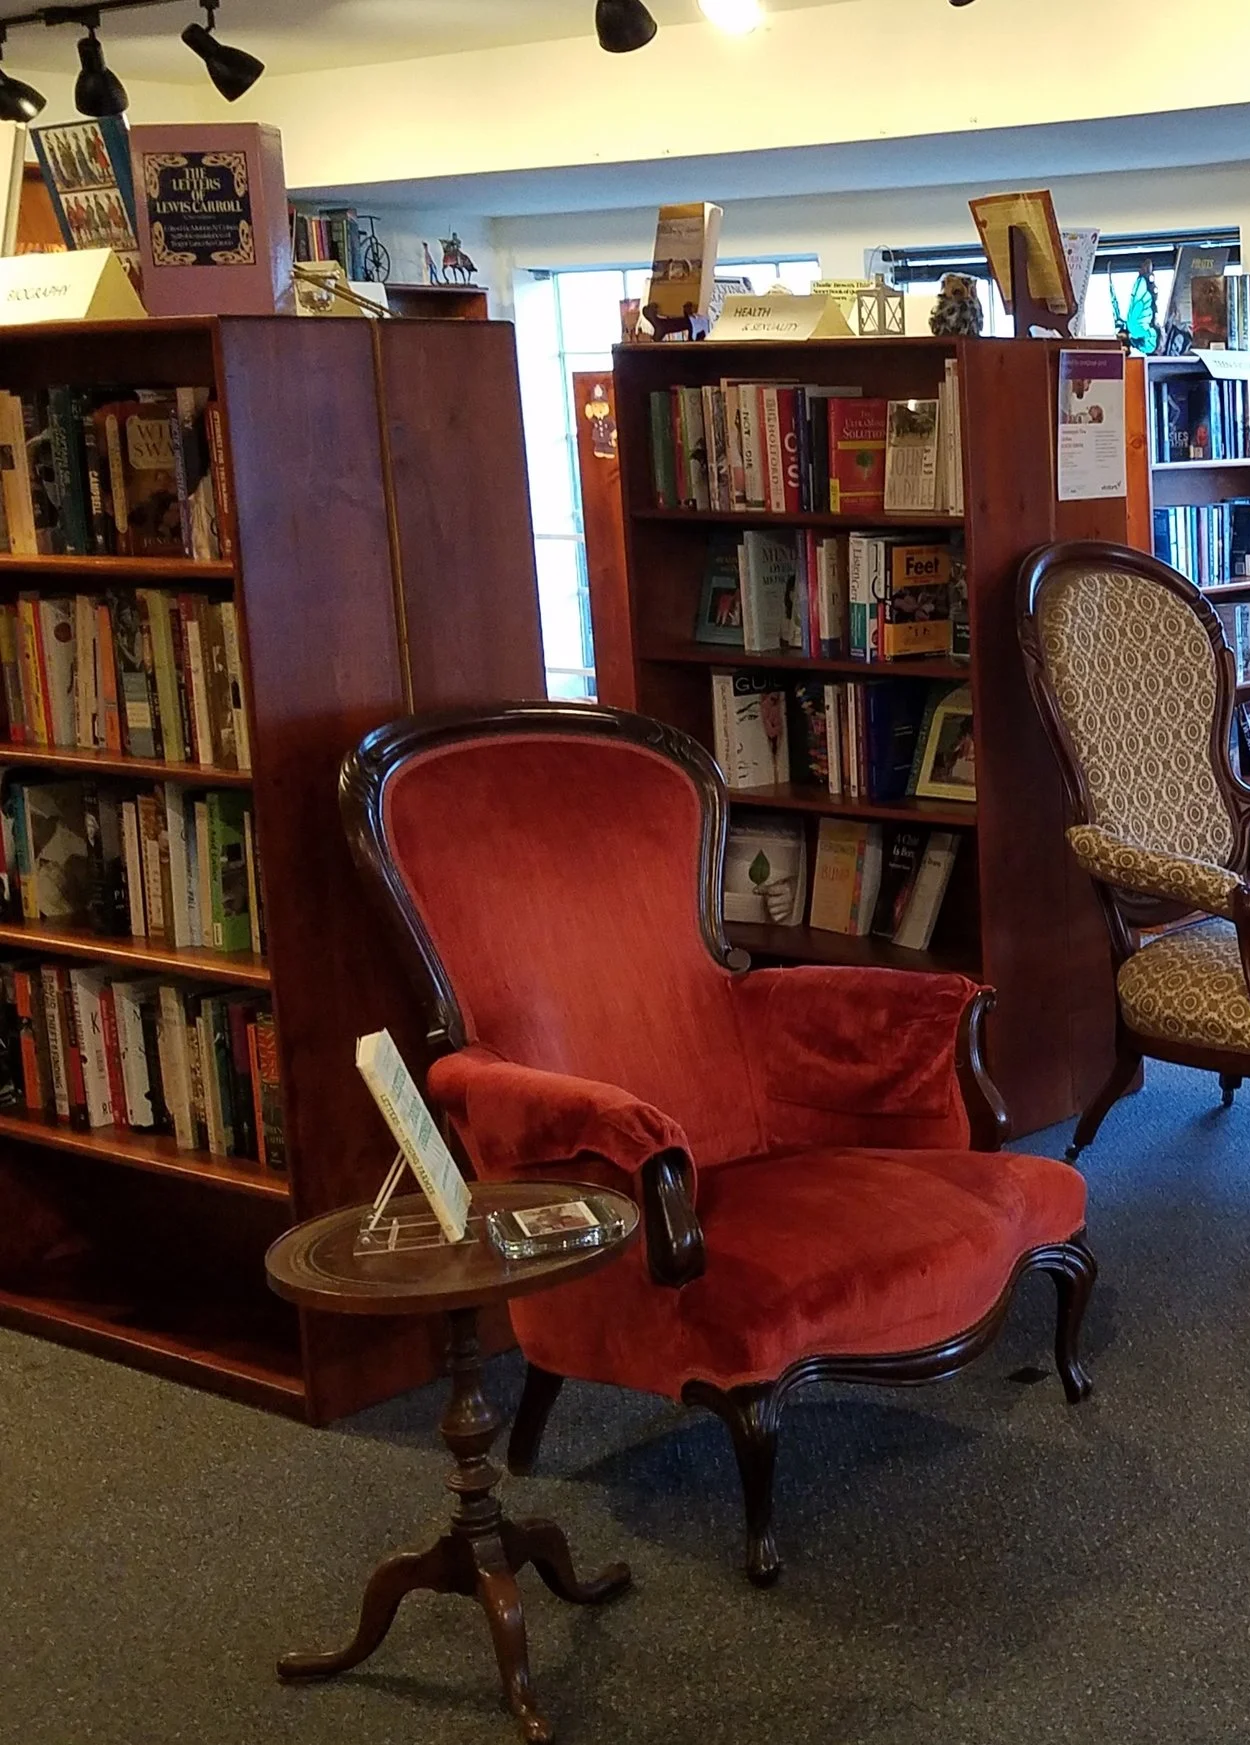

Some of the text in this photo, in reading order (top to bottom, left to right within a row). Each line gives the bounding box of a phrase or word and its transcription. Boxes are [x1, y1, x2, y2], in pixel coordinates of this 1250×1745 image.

[184, 168, 206, 179] THE
[172, 179, 221, 190] LETTERS
[191, 189, 205, 201] OF
[156, 200, 243, 213] LEWIS CARROLL
[734, 307, 772, 317] HEALTH
[750, 323, 799, 331] SEXUALITY
[905, 556, 940, 575] Feet
